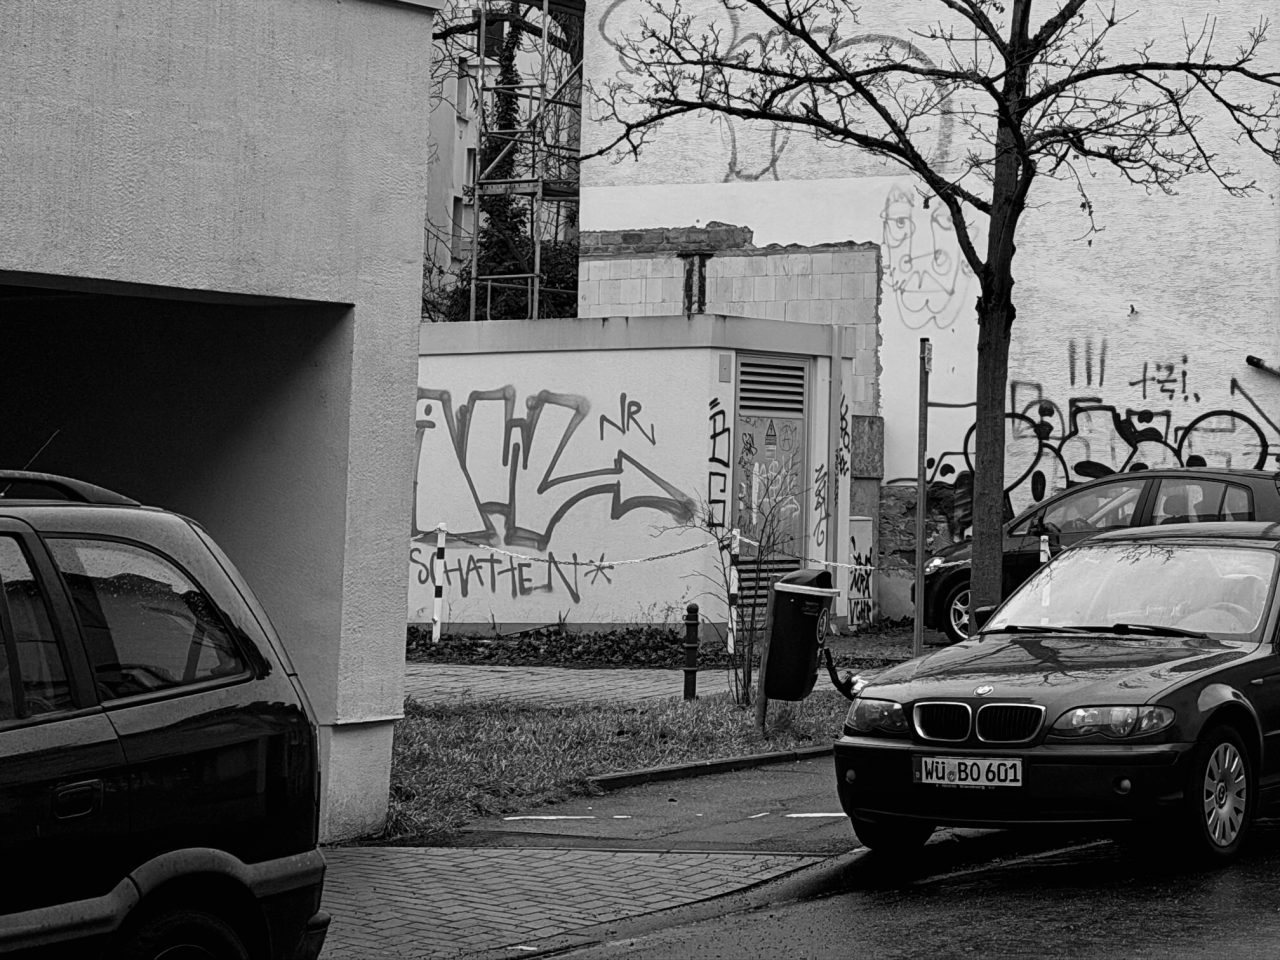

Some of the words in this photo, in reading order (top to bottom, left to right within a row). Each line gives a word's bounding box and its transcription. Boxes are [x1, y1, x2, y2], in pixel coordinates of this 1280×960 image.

[924, 760, 946, 781] WÜ
[957, 761, 981, 782] BO
[985, 762, 1020, 783] 601
